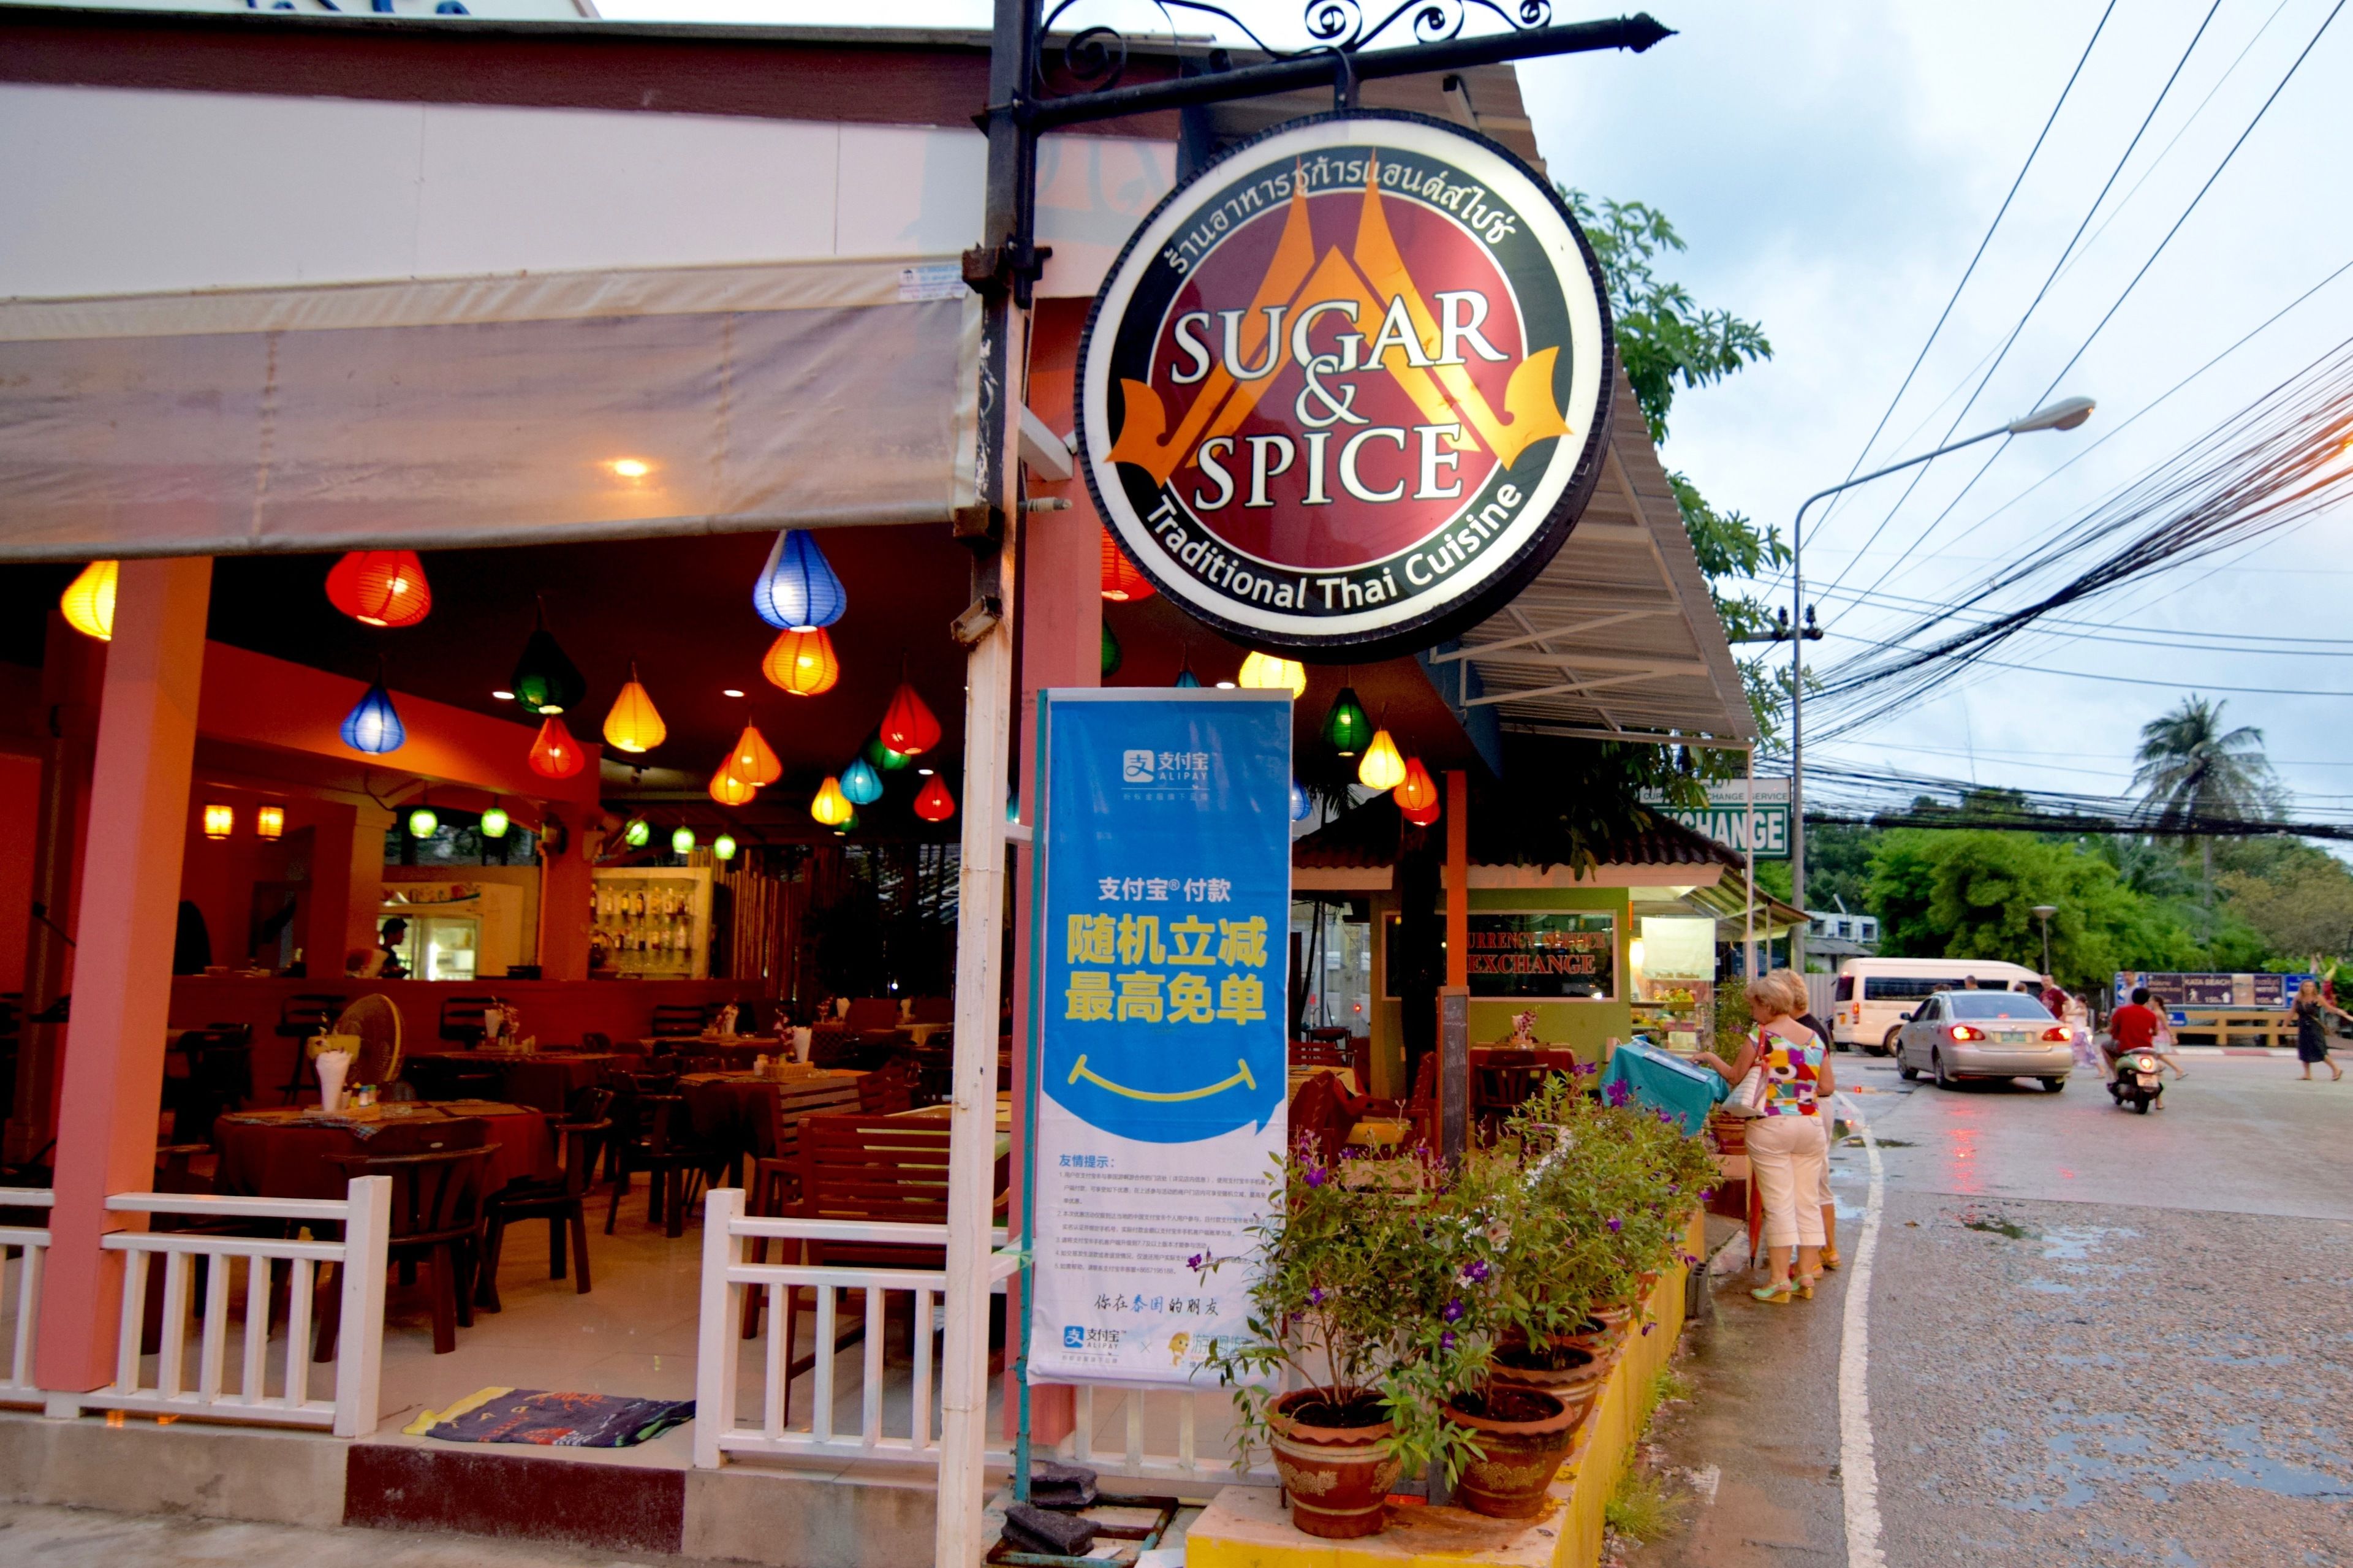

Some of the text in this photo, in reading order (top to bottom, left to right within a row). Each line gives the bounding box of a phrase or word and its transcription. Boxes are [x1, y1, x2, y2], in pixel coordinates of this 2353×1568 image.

[1170, 290, 1510, 384] SUGAR
[1295, 354, 1370, 428] &
[1194, 423, 1465, 510] SPICE
[1147, 483, 1522, 609] Traditional Thai Cuisine
[1157, 752, 1209, 771] 支付宝
[1159, 772, 1208, 781] ALIPAY
[1662, 811, 1784, 850] CHANGE
[1066, 914, 1268, 968] 随机立减
[1467, 954, 1596, 974] EXCHANGE
[1468, 931, 1605, 949] URRENCY SERVICE
[1065, 970, 1267, 1025] 最高免单
